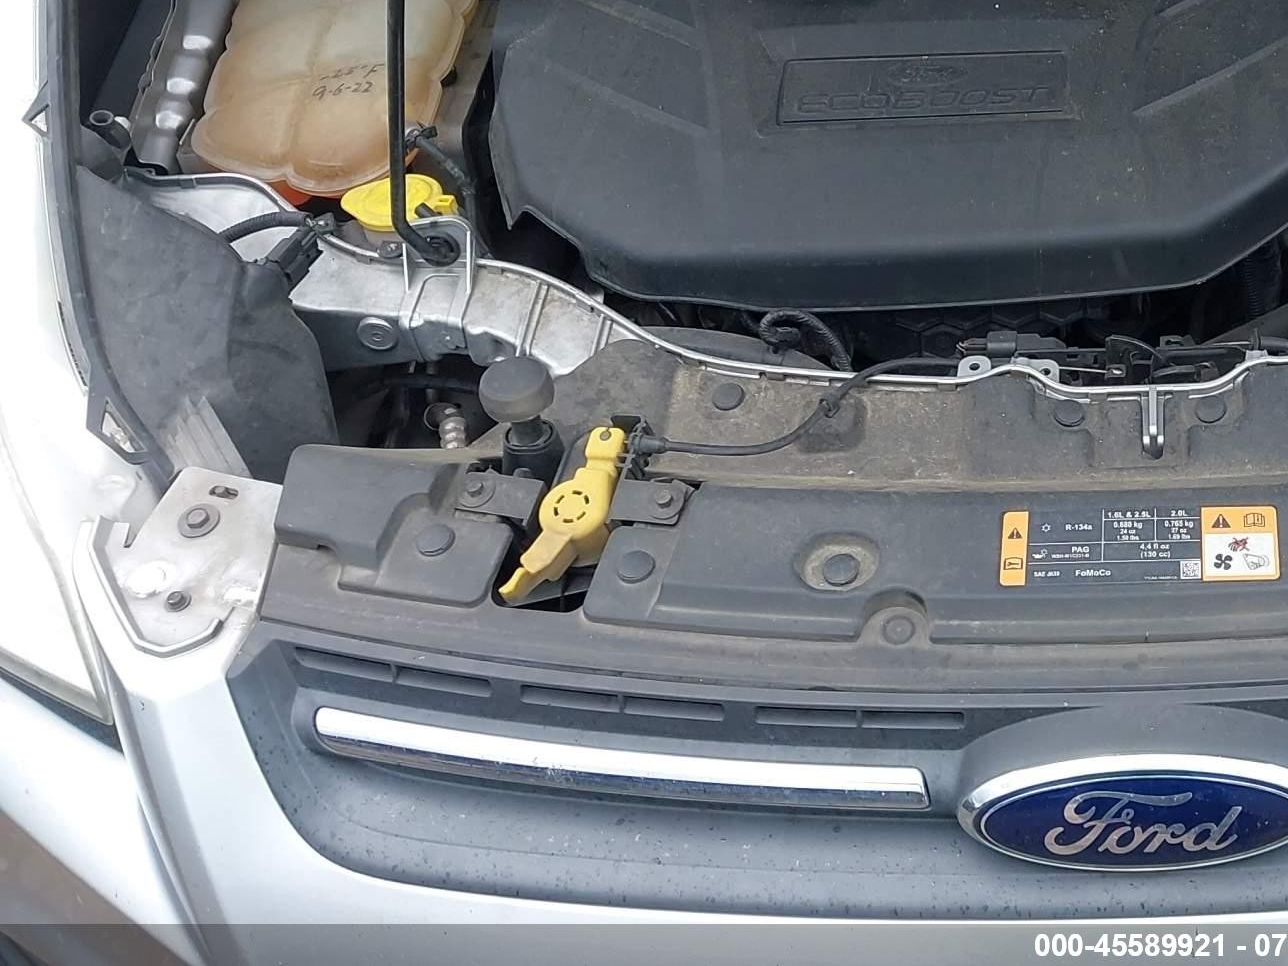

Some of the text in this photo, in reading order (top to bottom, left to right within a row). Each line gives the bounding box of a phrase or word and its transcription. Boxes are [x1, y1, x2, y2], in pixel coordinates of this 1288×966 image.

[798, 87, 1049, 114] ECOBOOST
[1170, 509, 1188, 517] 2.0L
[1065, 523, 1093, 531] R-134a
[1133, 521, 1143, 529] kg
[1184, 520, 1194, 529] kg
[1075, 569, 1112, 577] FoMoCo
[1043, 791, 1243, 856] Ford
